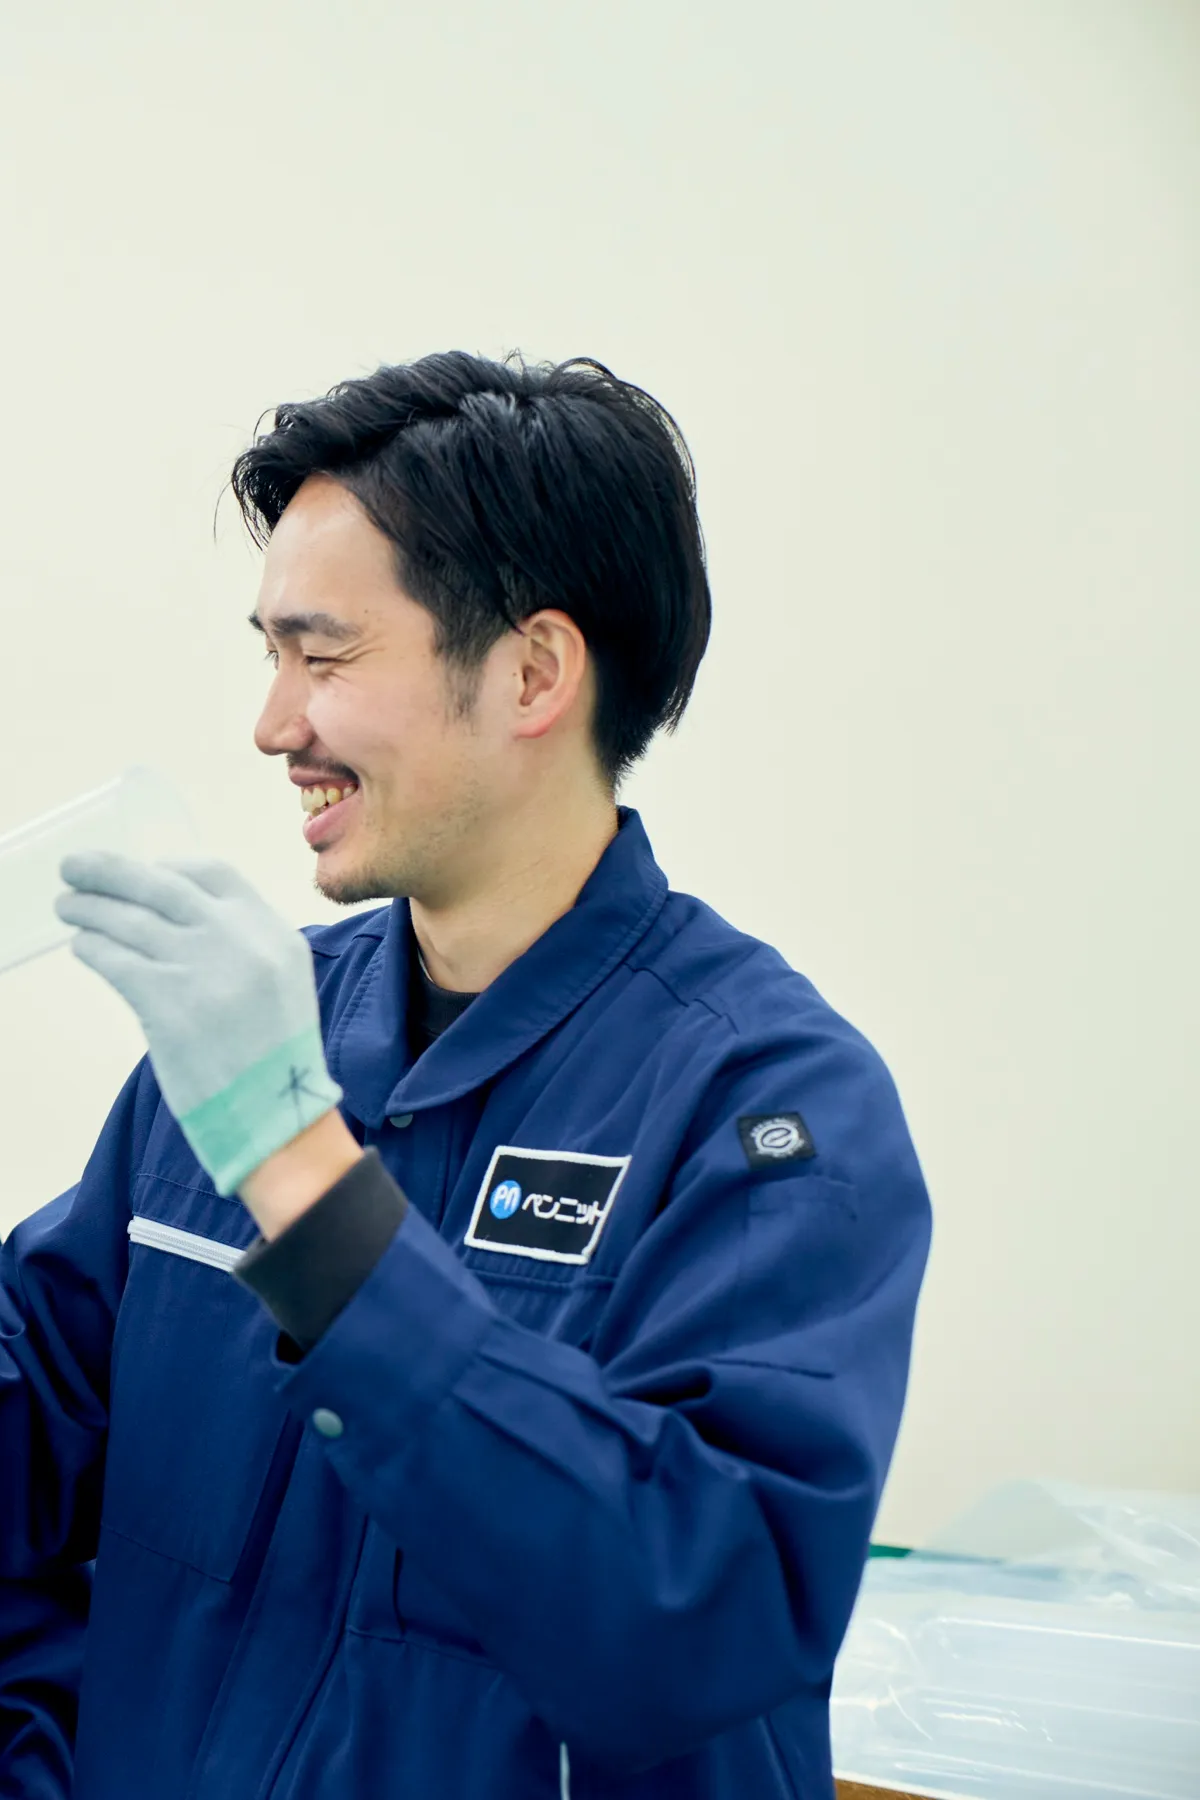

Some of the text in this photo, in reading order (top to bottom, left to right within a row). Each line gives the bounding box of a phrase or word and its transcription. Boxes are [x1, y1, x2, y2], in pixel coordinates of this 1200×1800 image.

[521, 1193, 605, 1225] ペンニット
